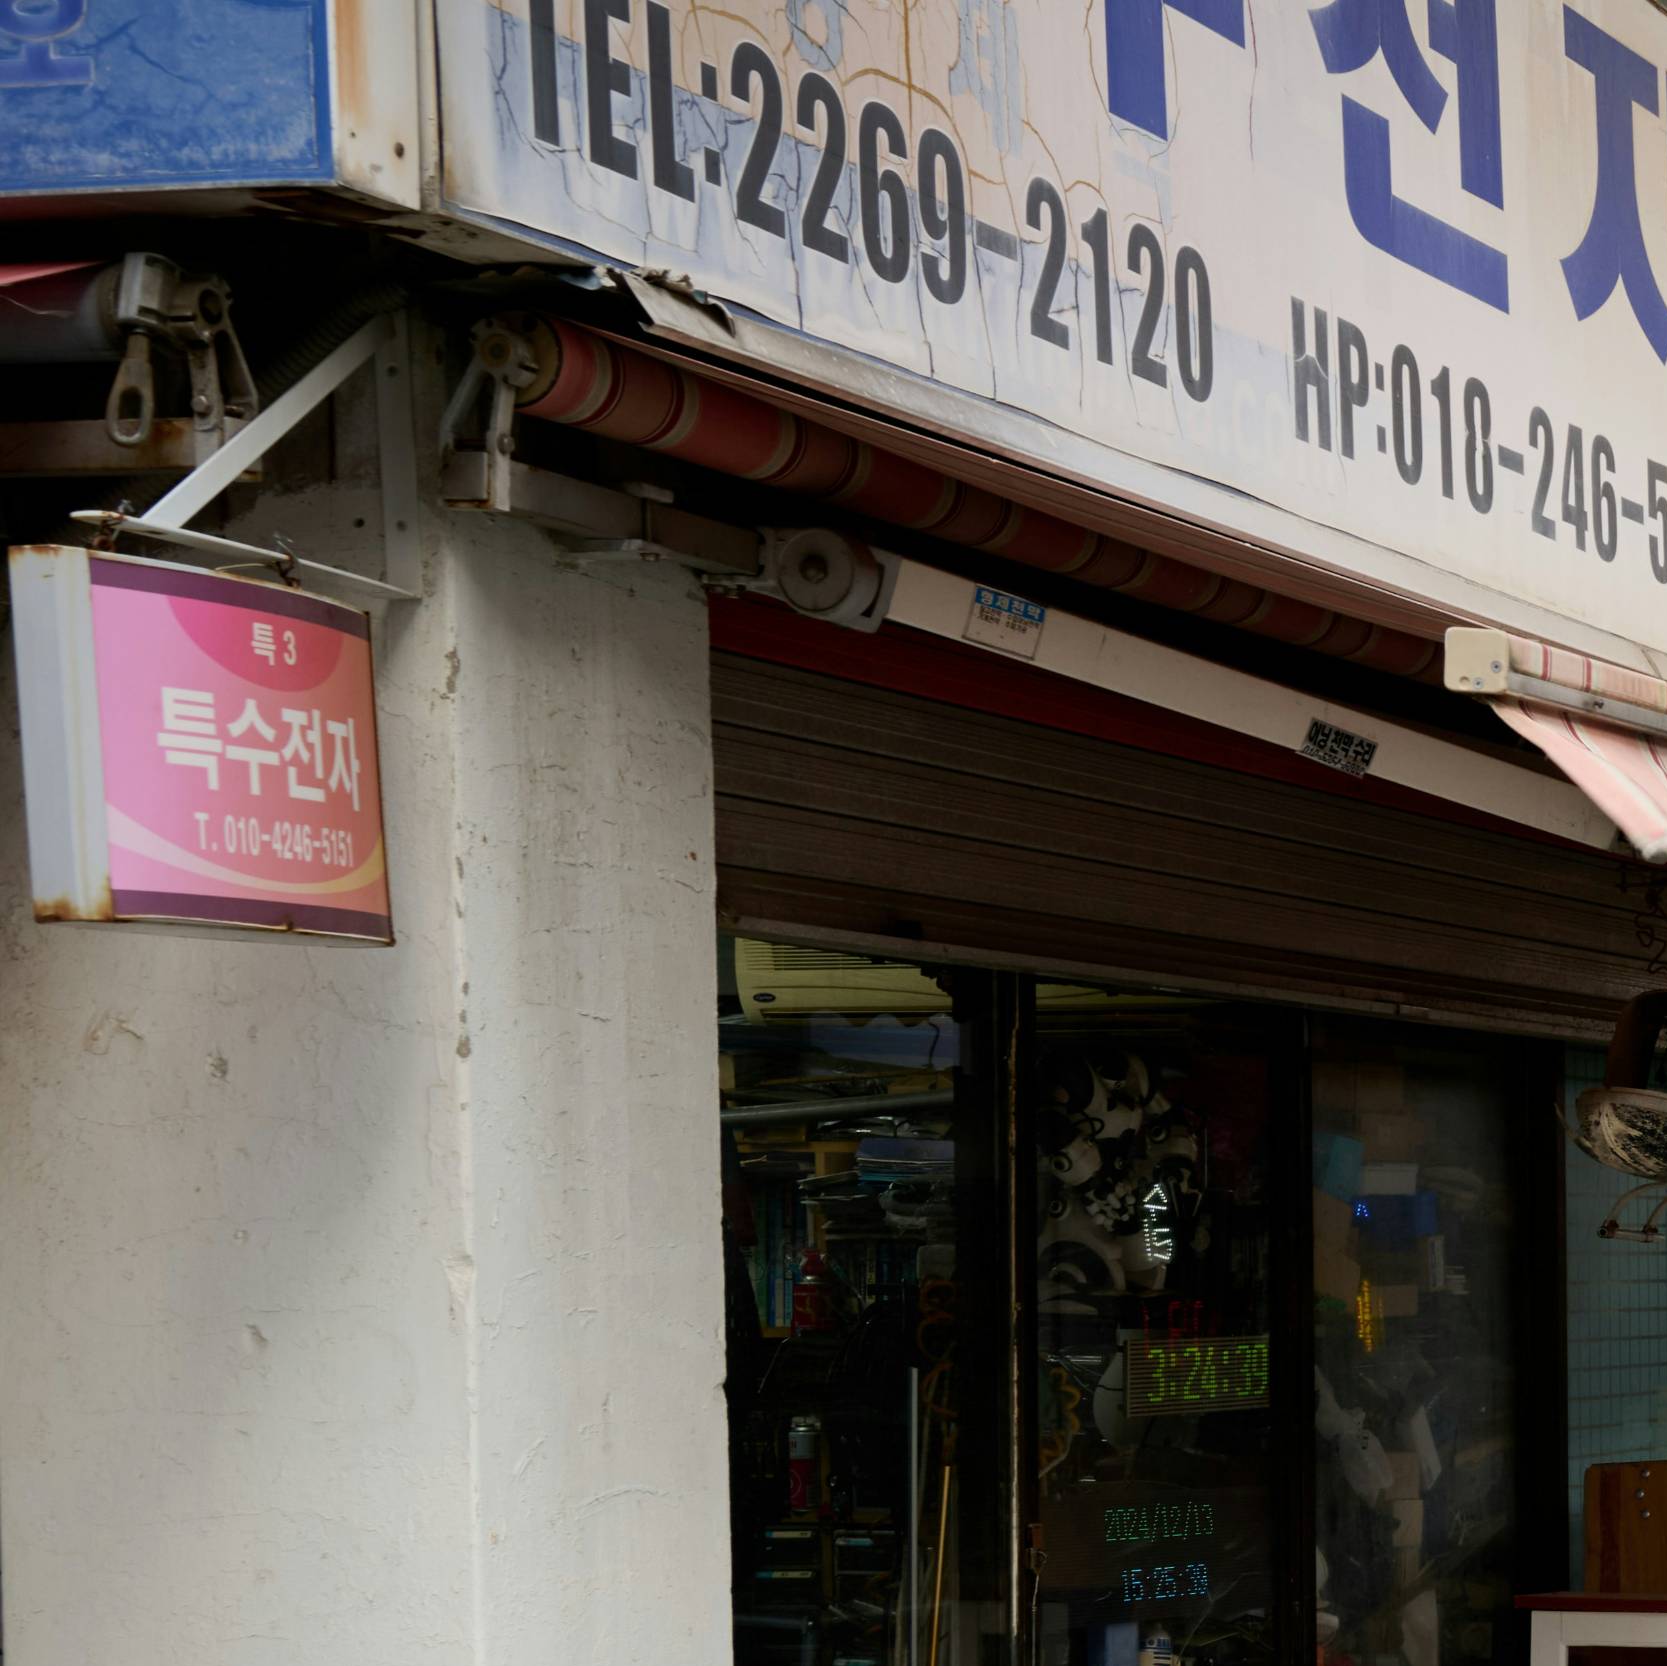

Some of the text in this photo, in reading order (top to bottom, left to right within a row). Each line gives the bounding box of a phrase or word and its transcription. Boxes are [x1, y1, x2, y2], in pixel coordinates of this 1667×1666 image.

[252, 623, 297, 665] 특 3
[157, 687, 362, 812] 특수전자
[223, 814, 354, 868] 010-4246-5151
